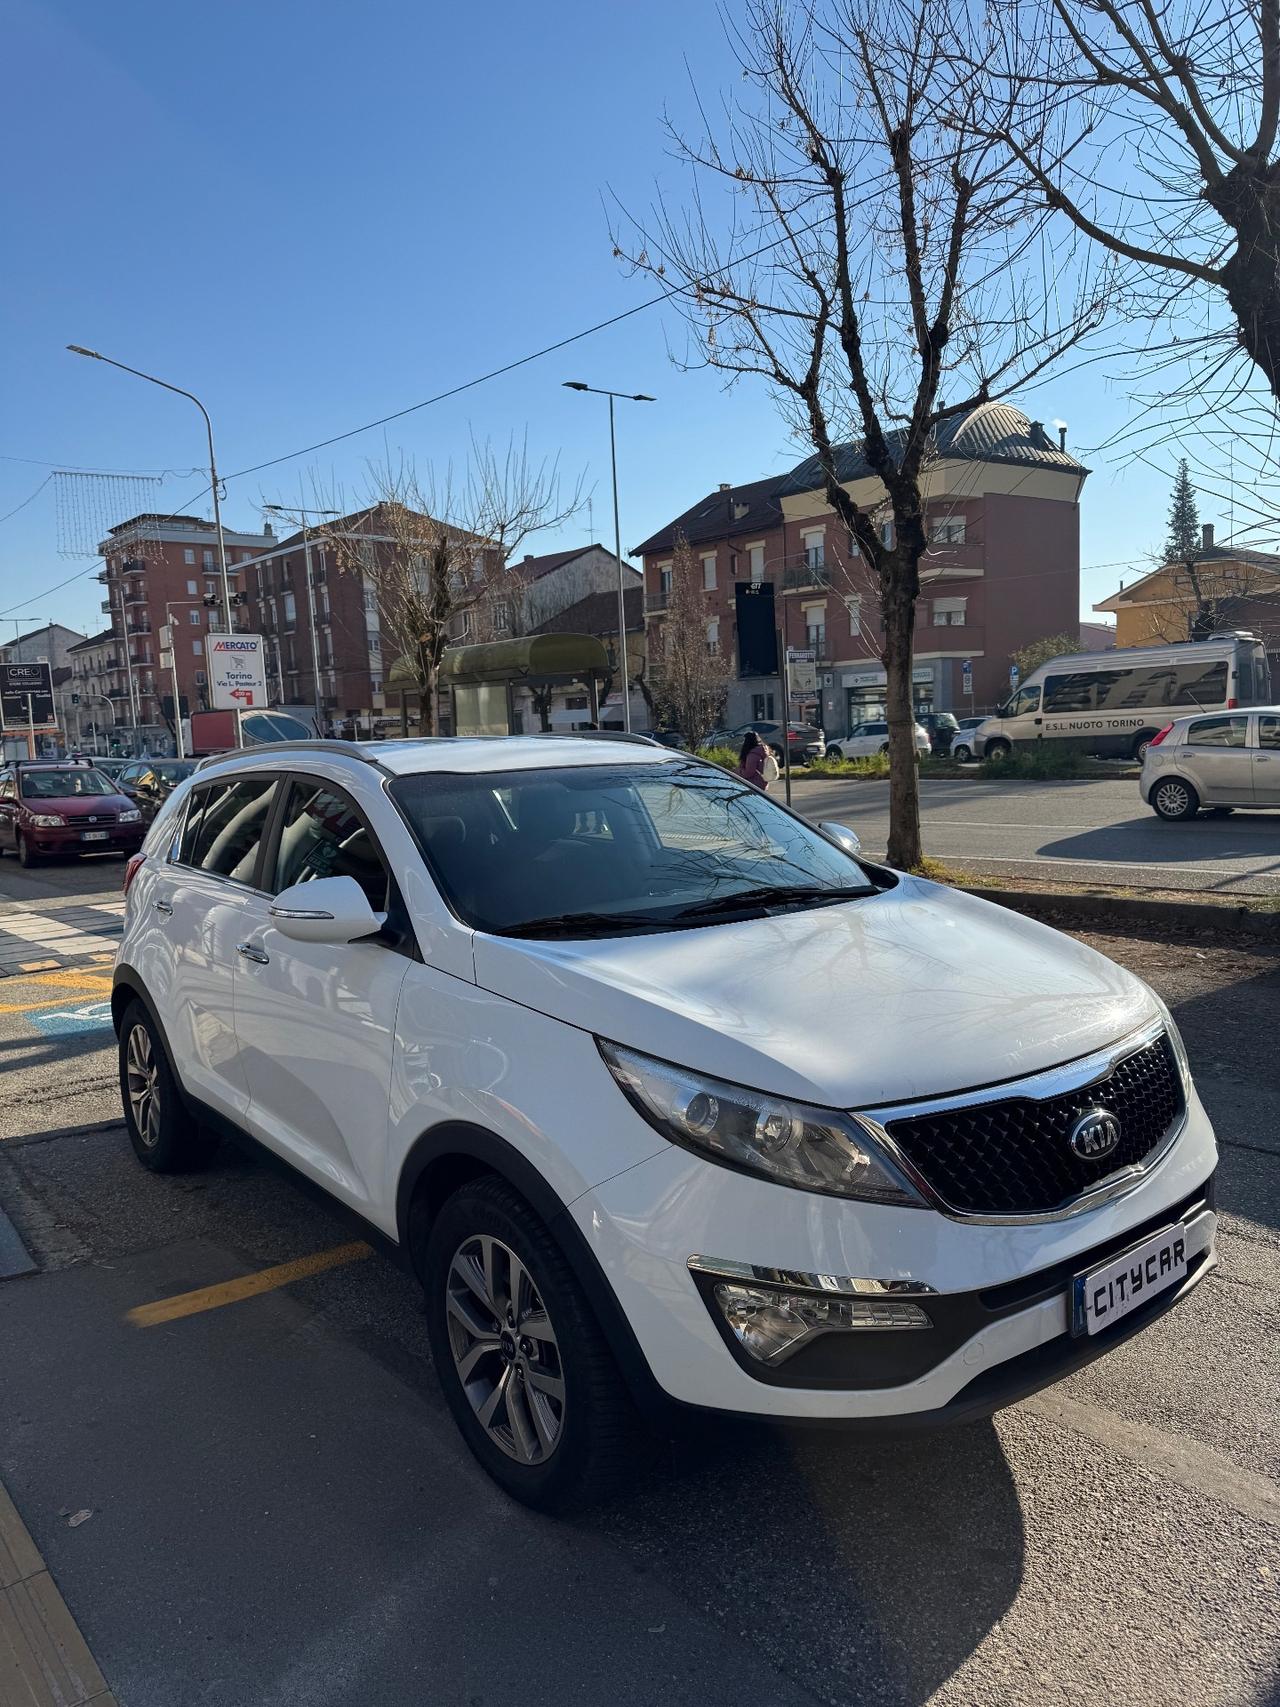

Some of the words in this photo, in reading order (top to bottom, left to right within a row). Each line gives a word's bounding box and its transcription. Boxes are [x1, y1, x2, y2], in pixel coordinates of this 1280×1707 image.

[214, 641, 257, 651] MERCATO
[10, 668, 40, 676] CREO
[1011, 666, 1017, 675] P
[1069, 721, 1103, 729] NUOTO
[1107, 719, 1144, 728] TORINO
[1082, 1120, 1118, 1153] KIA
[1093, 1238, 1185, 1318] CITYCAR
